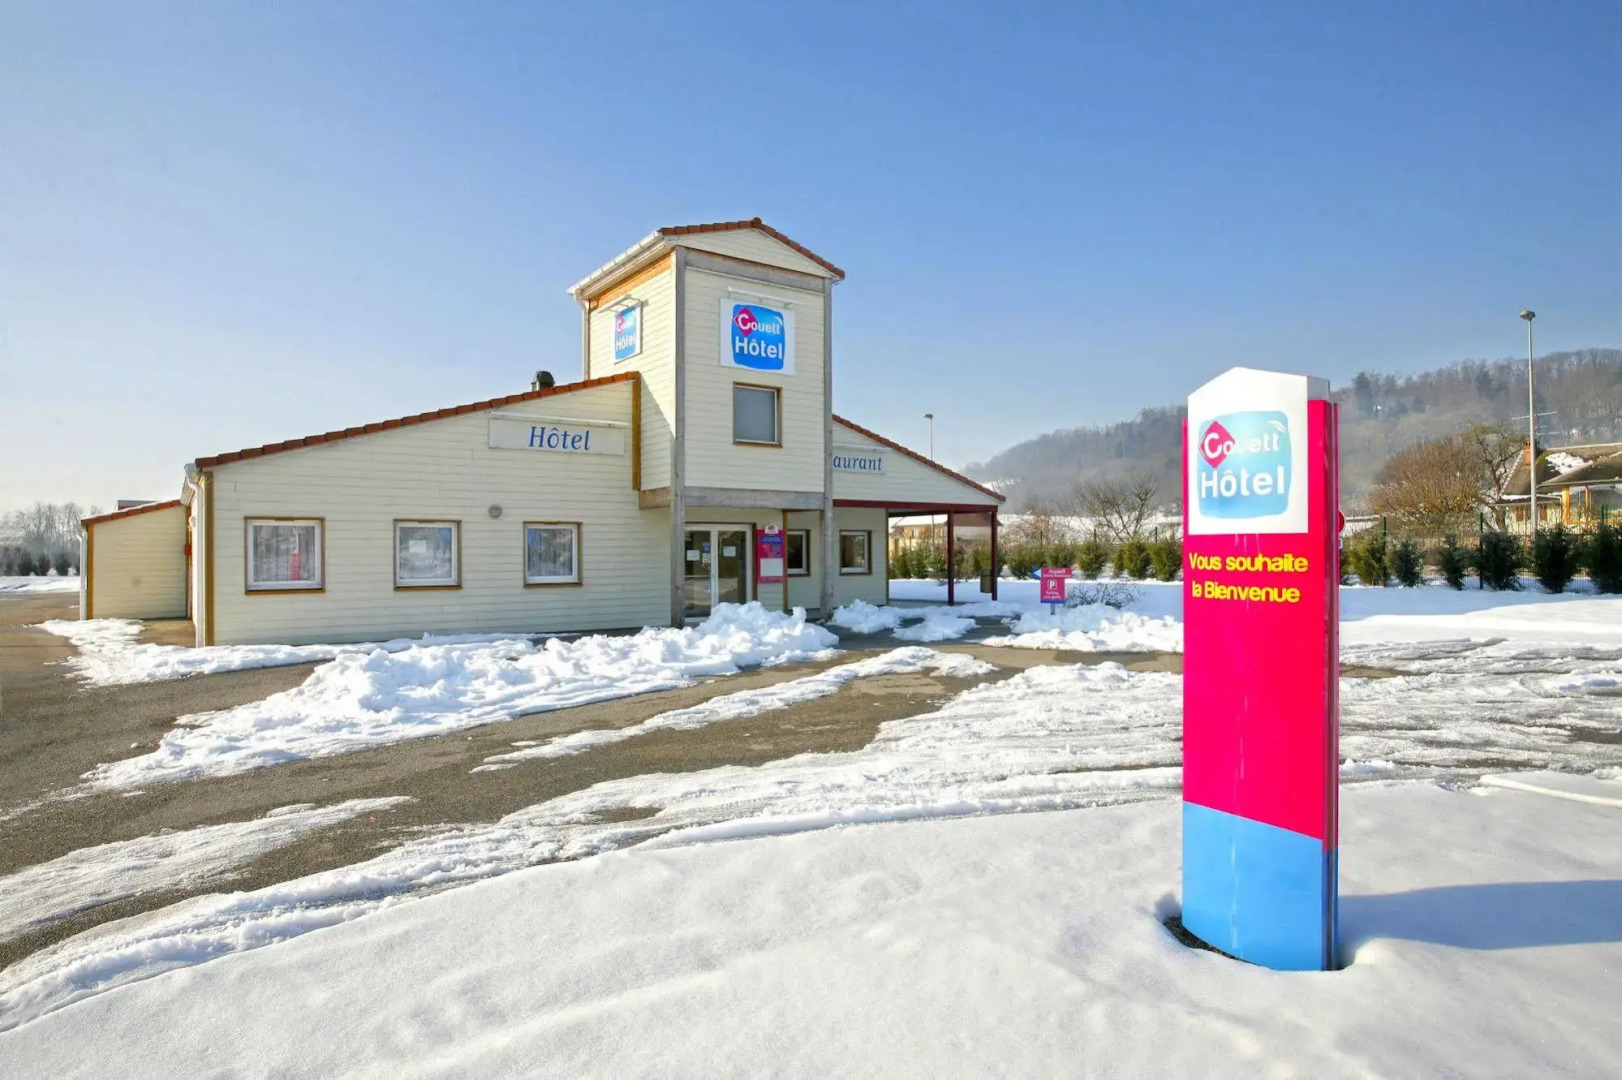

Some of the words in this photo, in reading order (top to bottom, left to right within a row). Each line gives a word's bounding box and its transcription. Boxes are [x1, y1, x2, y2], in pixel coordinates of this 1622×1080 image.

[735, 336, 783, 359] Hôtel
[528, 426, 590, 451] Hôtel
[833, 456, 884, 471] aurant
[1201, 465, 1285, 499] Hôtel
[1188, 552, 1222, 571] Vous
[1225, 553, 1309, 573] souhaite
[1049, 580, 1056, 589] P
[1192, 580, 1202, 598] la
[1204, 581, 1300, 603] Bienvenue
